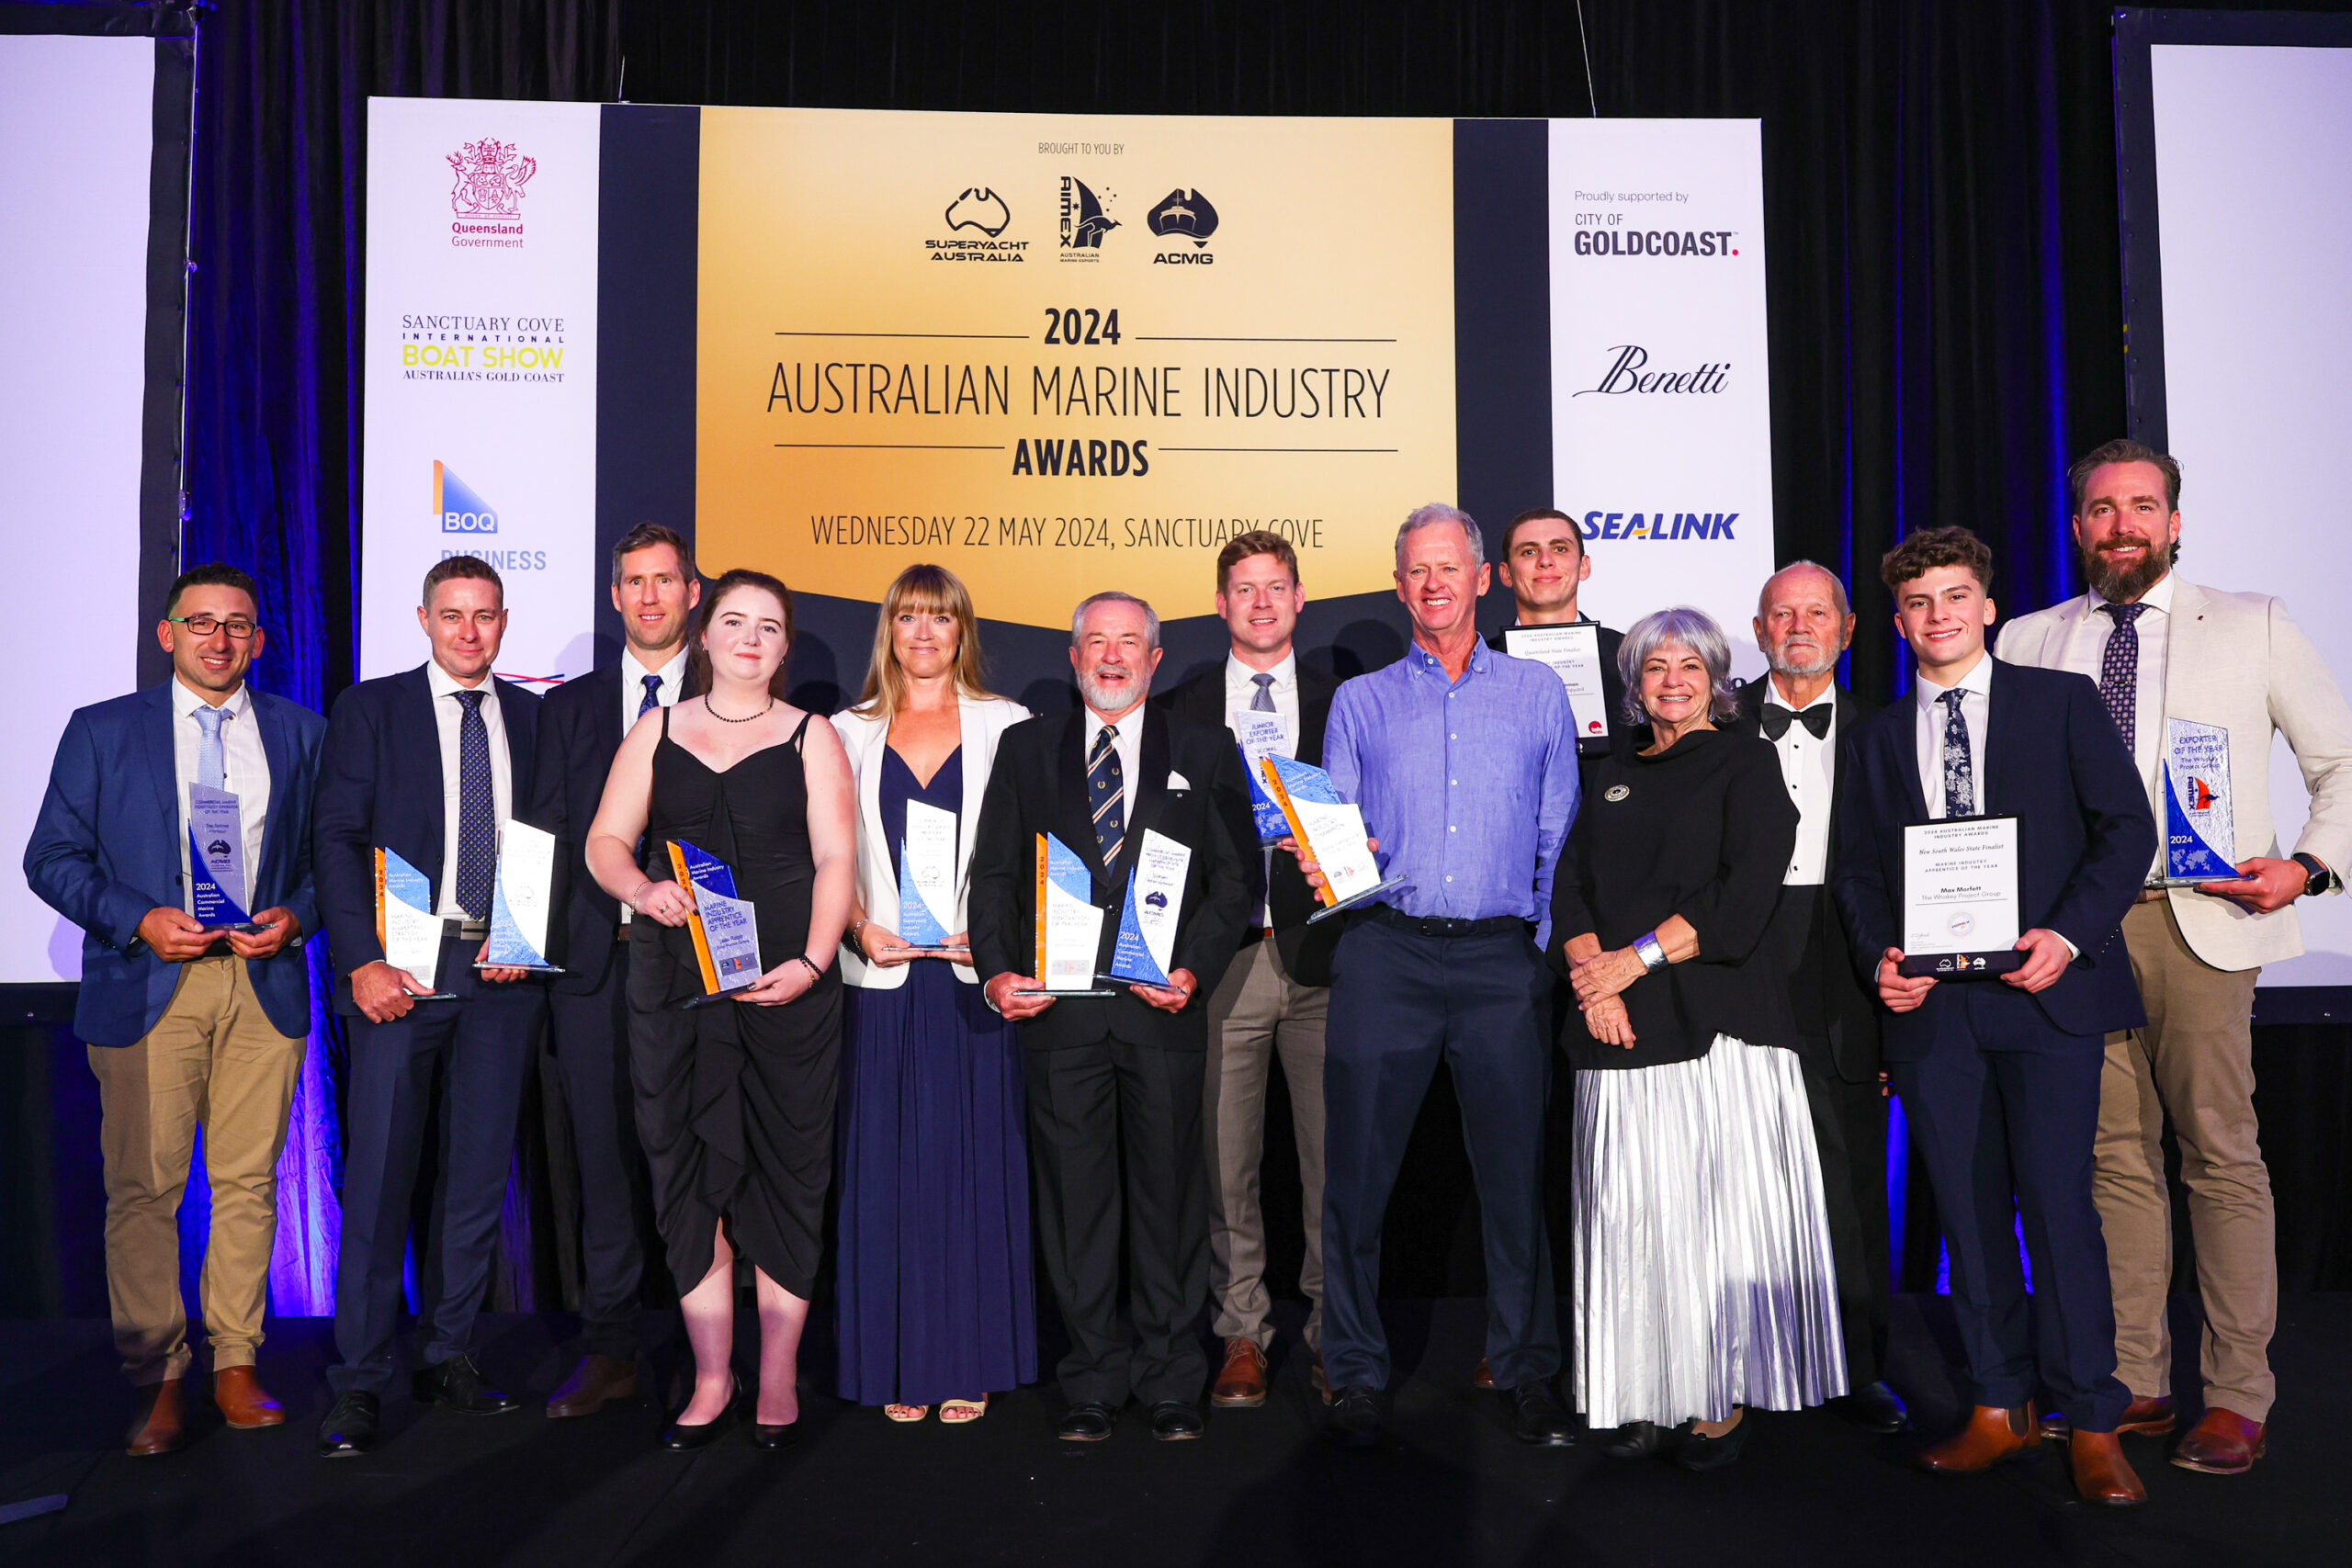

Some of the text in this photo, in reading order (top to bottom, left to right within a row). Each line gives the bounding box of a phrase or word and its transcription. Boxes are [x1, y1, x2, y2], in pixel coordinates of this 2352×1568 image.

[1038, 142, 1125, 155] BROUGHT TO YOU BY
[1574, 190, 1689, 205] Proudly supported by
[1060, 175, 1071, 248] AIMEX
[1574, 213, 1623, 226] CITY OF
[452, 221, 524, 234] Queensland
[451, 236, 524, 248] Government
[925, 240, 1029, 251] SUPERYACHT
[931, 252, 1024, 263] AUSTRALIA
[1153, 253, 1214, 265] ACMG
[402, 314, 564, 333] SANCTUARY COVE
[1044, 308, 1122, 346] 2024
[402, 333, 564, 344] INTERNATIONAL
[402, 344, 564, 369] BOAT SHOW
[402, 369, 565, 383] AUSTRALIA'S GOLD COAST
[1572, 344, 1731, 398] Benetti
[766, 361, 1390, 419] AUSTRALIAN MARINE INDUSTRY
[1012, 438, 1149, 478] AWARDS
[445, 512, 495, 531] BOQ
[1582, 511, 1740, 541] SEALINK
[810, 515, 956, 546] WEDNESDAY
[963, 516, 989, 547] 22
[999, 516, 1046, 547] MAY
[1054, 517, 1115, 550] 2024,
[1251, 721, 1274, 729] JUNIOR
[1250, 728, 1278, 738] EXPORTER
[2179, 735, 2218, 744] EXPORTER
[2188, 745, 2202, 753] THE
[2203, 744, 2223, 752] YEAR
[1251, 802, 1271, 811] 2024
[2170, 835, 2193, 844] 2024
[690, 862, 712, 870] Australian
[196, 883, 216, 891] 2024
[704, 900, 727, 910] MARINE
[903, 901, 922, 909] 2024
[706, 906, 734, 918] INDUSTRY
[707, 911, 742, 925] APPRENTICE
[732, 918, 748, 926] YEAR
[1120, 931, 1140, 942] 2024
